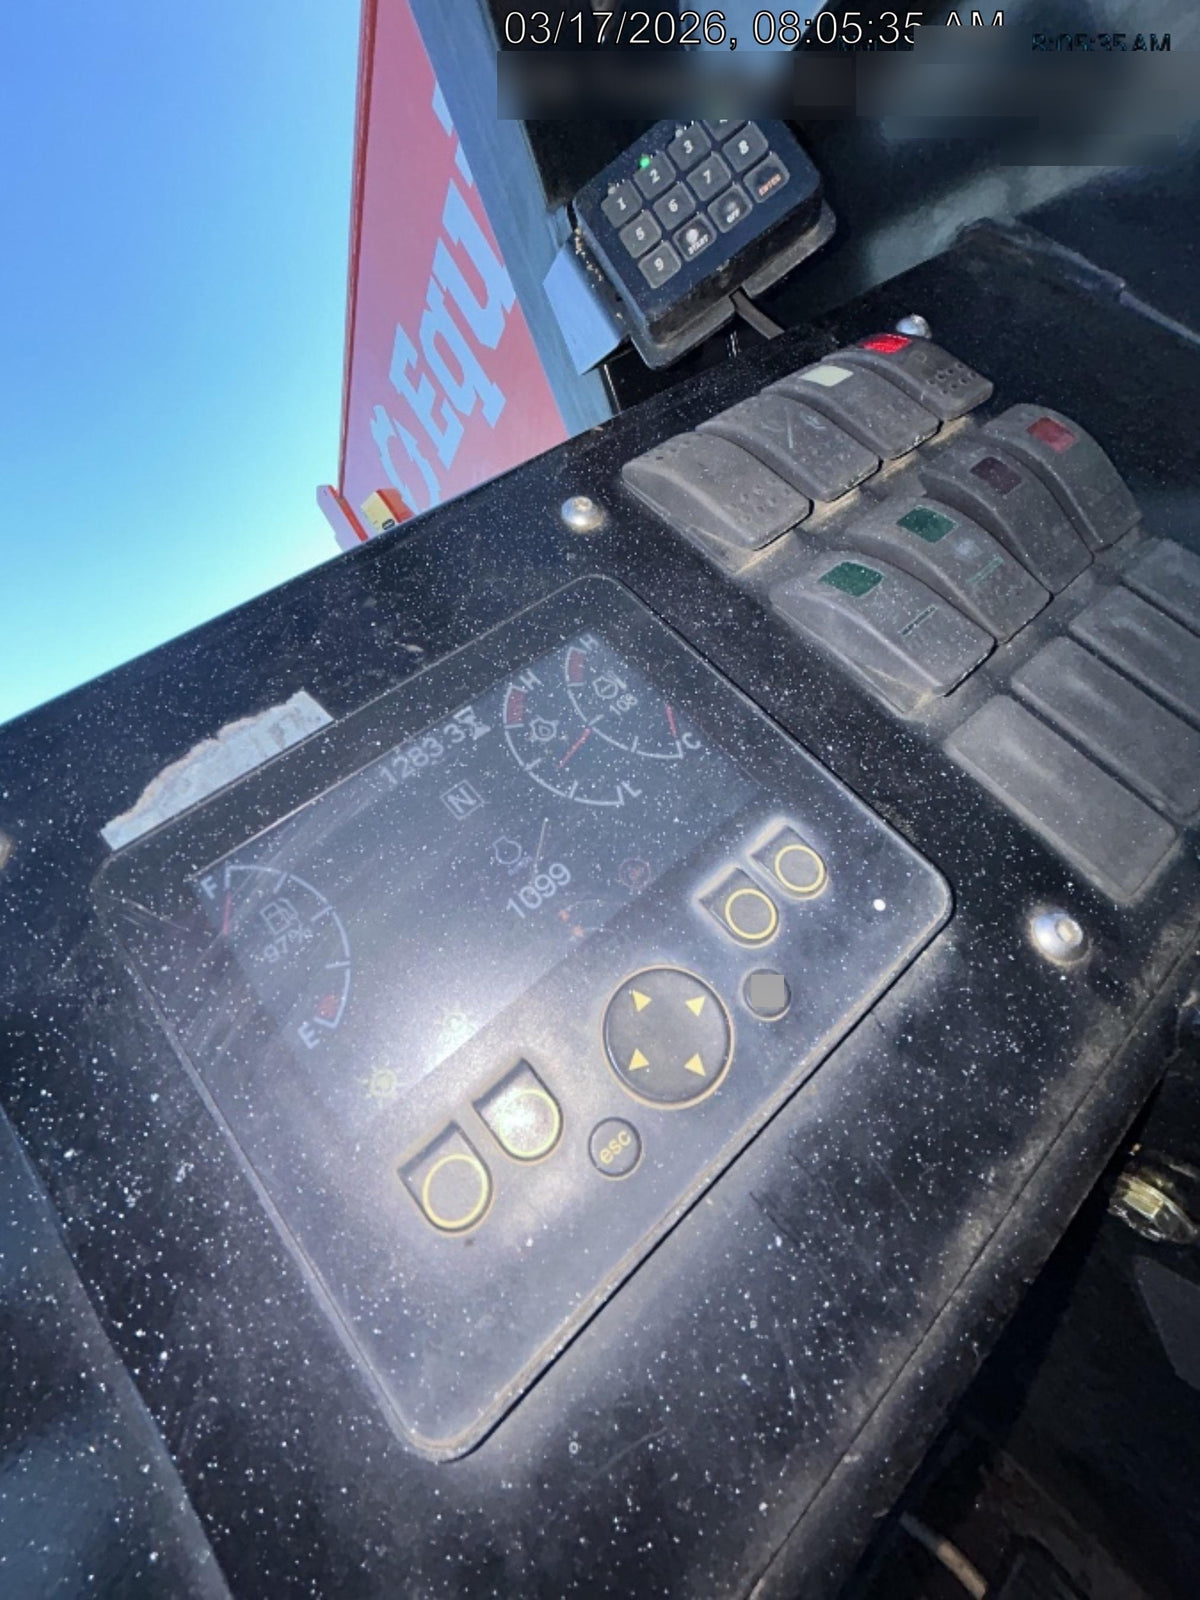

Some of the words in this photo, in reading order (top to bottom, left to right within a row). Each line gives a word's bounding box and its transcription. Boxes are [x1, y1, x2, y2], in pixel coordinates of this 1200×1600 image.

[683, 139, 694, 154] 3
[738, 140, 749, 155] 8
[650, 169, 660, 184] 2
[703, 170, 713, 184] 7
[616, 197, 627, 211] 1
[668, 199, 679, 213] 6
[635, 227, 646, 241] 5
[653, 257, 664, 271] 9
[578, 634, 600, 652] H
[519, 668, 543, 691] H
[682, 732, 701, 749] C
[621, 780, 643, 797] L
[447, 787, 477, 815] N
[200, 875, 218, 899] F
[506, 863, 571, 918] 1099
[298, 1021, 320, 1049] E
[600, 1130, 631, 1165] esc
